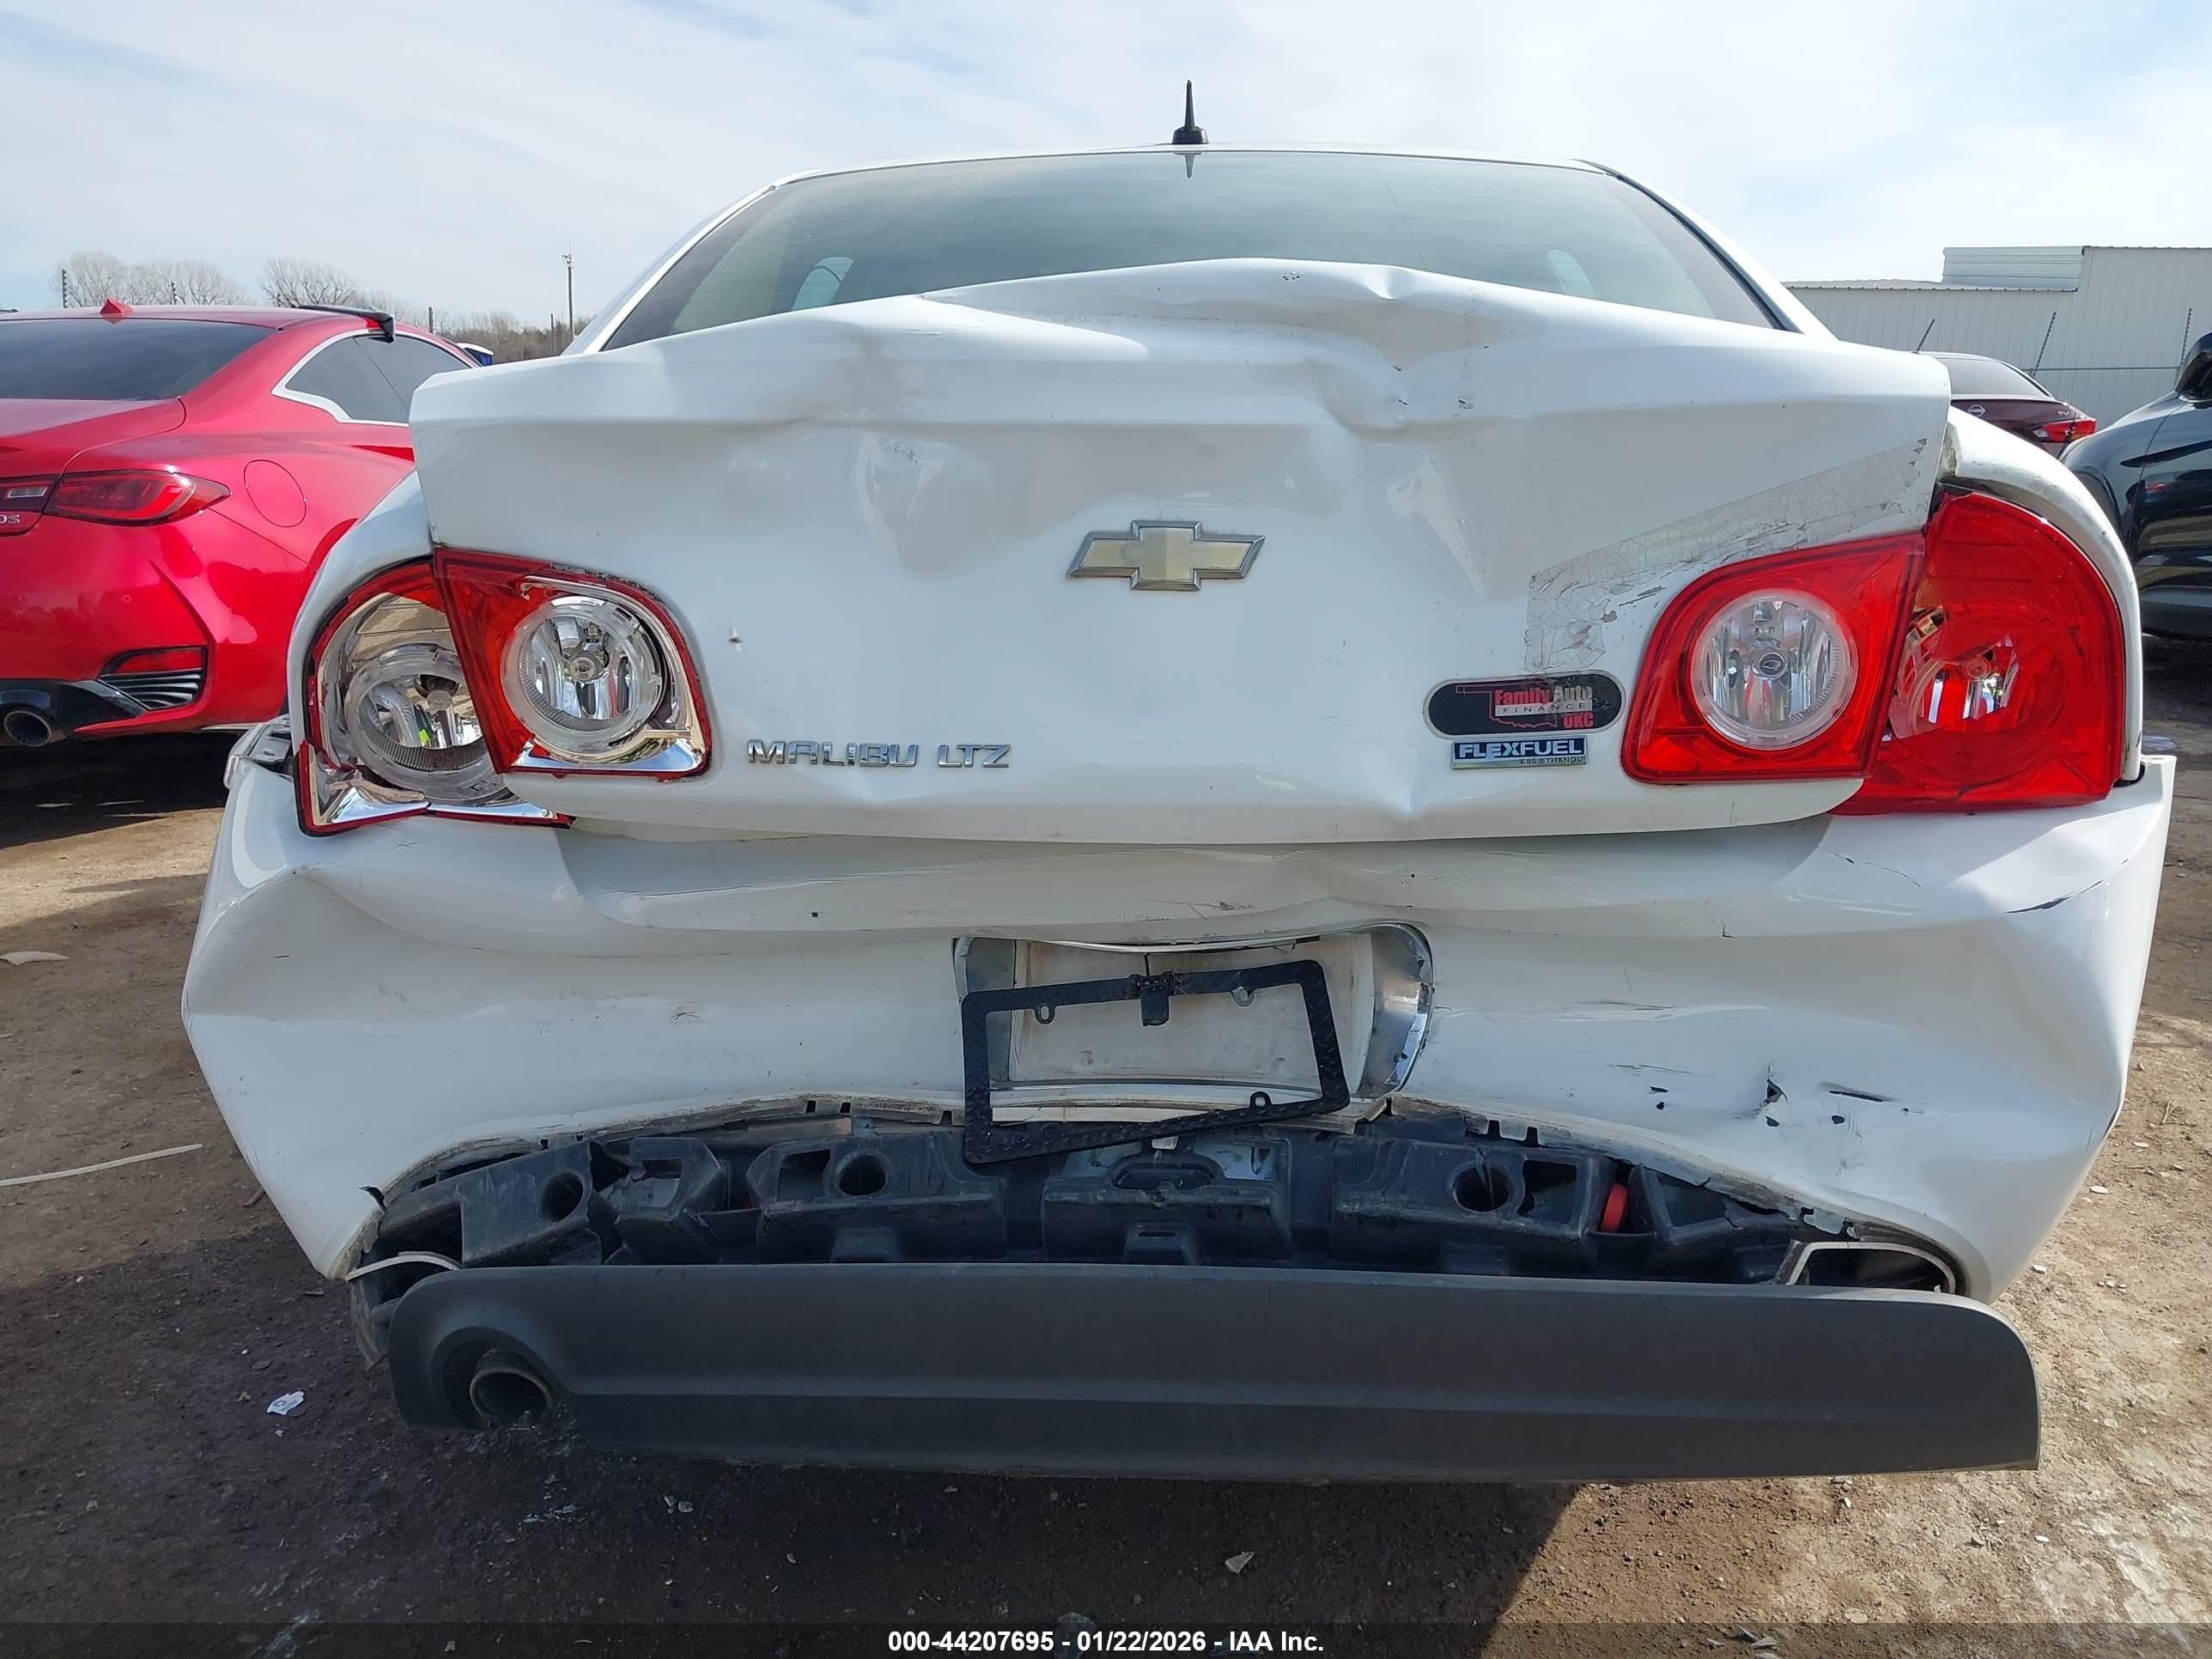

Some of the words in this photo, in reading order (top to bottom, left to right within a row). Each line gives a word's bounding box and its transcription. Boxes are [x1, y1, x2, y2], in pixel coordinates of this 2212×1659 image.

[1495, 688, 1551, 704] Family
[1553, 685, 1593, 703] Auto
[1503, 703, 1586, 714] FINANCE
[747, 739, 919, 767] MALIBU
[938, 744, 1011, 768] LTZ
[1459, 739, 1583, 759] FLEXFUEL
